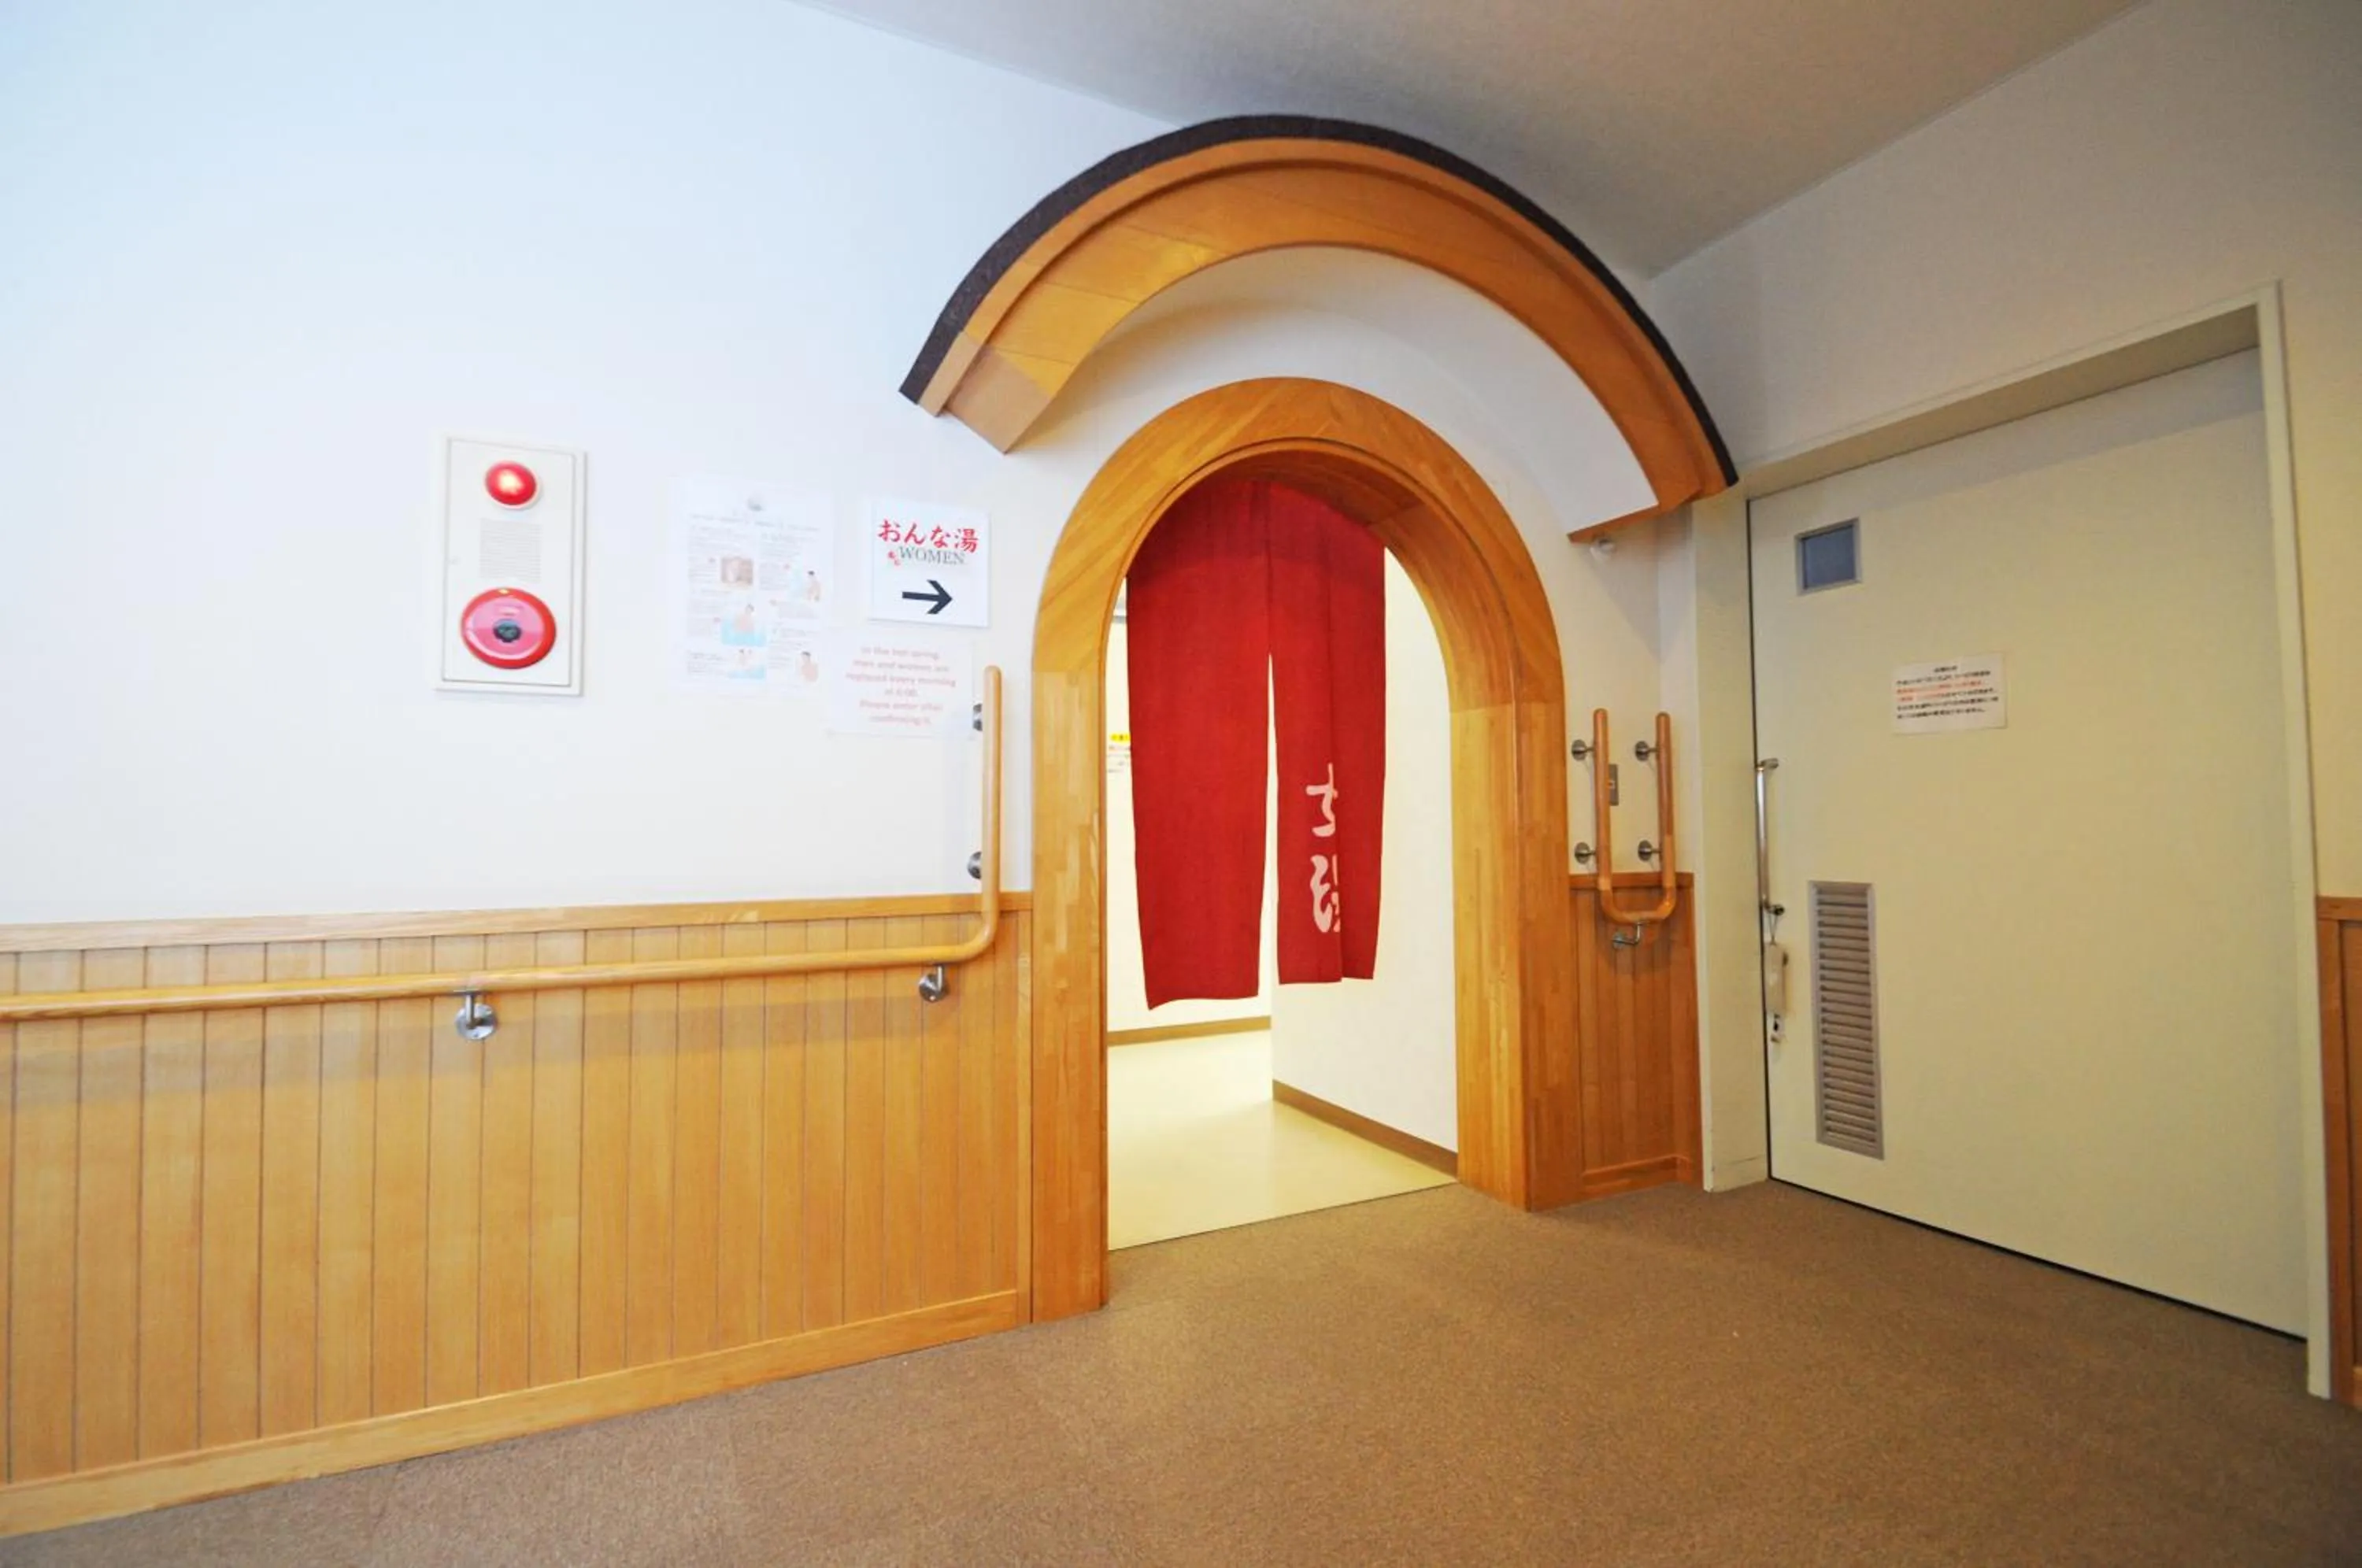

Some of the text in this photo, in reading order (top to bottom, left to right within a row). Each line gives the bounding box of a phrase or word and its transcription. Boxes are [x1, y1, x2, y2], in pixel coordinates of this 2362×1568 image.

[878, 519, 979, 553] おんな湯
[898, 545, 966, 565] WOMEN
[859, 699, 890, 710] Please
